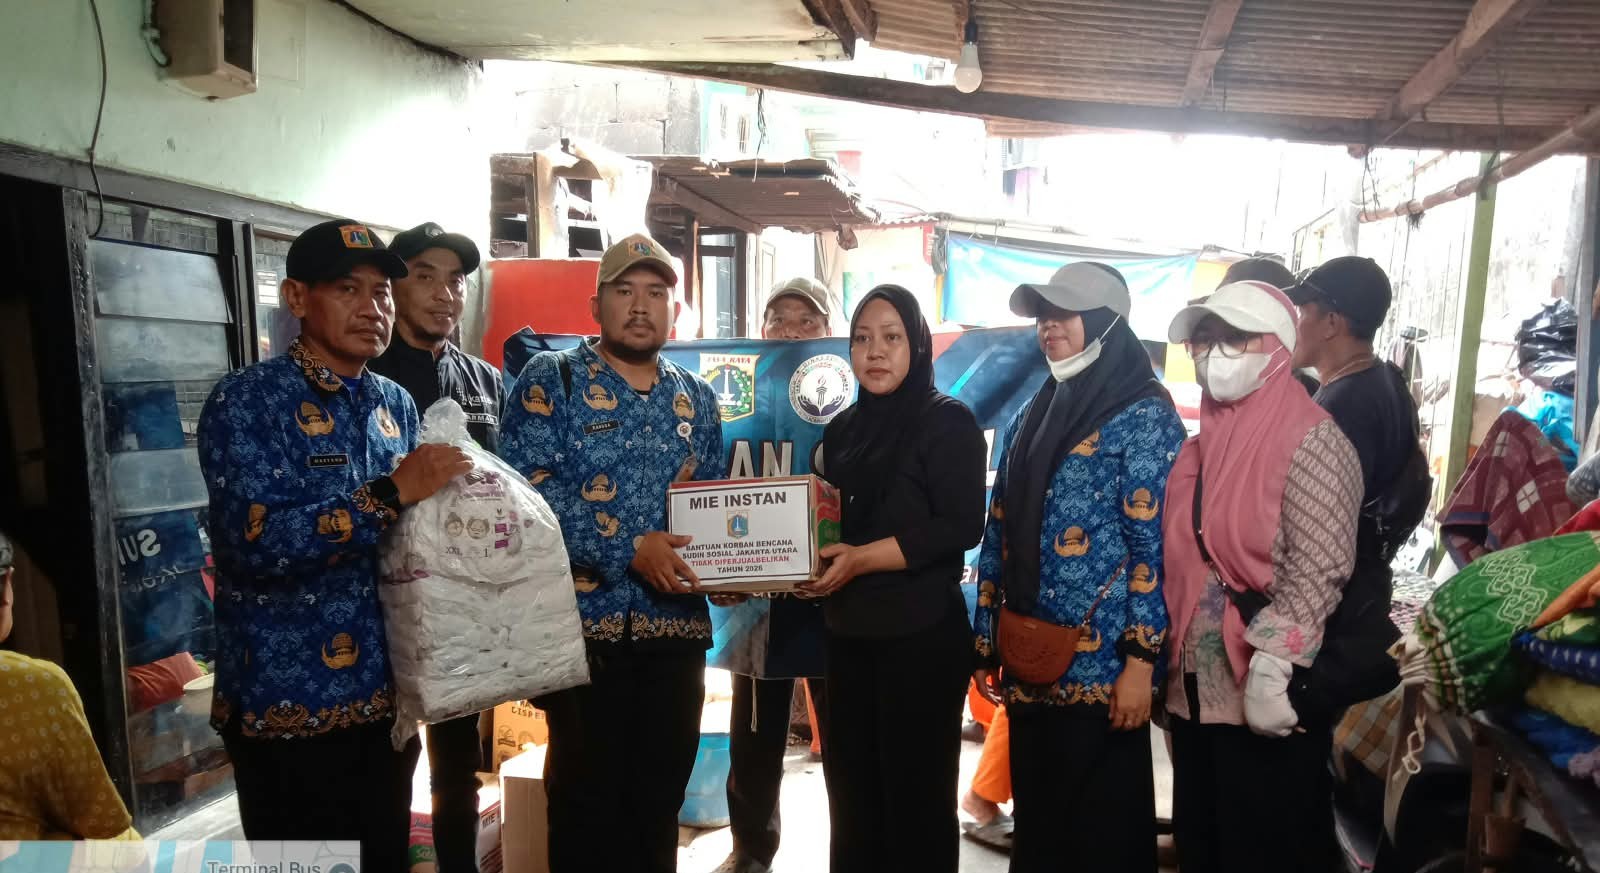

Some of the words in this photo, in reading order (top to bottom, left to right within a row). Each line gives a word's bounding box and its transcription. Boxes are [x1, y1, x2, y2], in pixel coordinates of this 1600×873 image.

[690, 496, 719, 510] MIE
[725, 491, 787, 507] INSTAN
[686, 543, 721, 551] BANTUAN
[723, 541, 754, 549] KORBAN
[756, 539, 793, 547] BENCANA
[682, 552, 705, 560] SUDIN
[706, 550, 734, 558] SOSIAL
[735, 547, 771, 556] JAKARTA
[772, 546, 798, 554] UTARA
[691, 559, 713, 567] TIDAK
[714, 555, 790, 566] DIPERJUALBELIKAN
[717, 565, 743, 574] TAHUN
[482, 812, 496, 829] MIE
